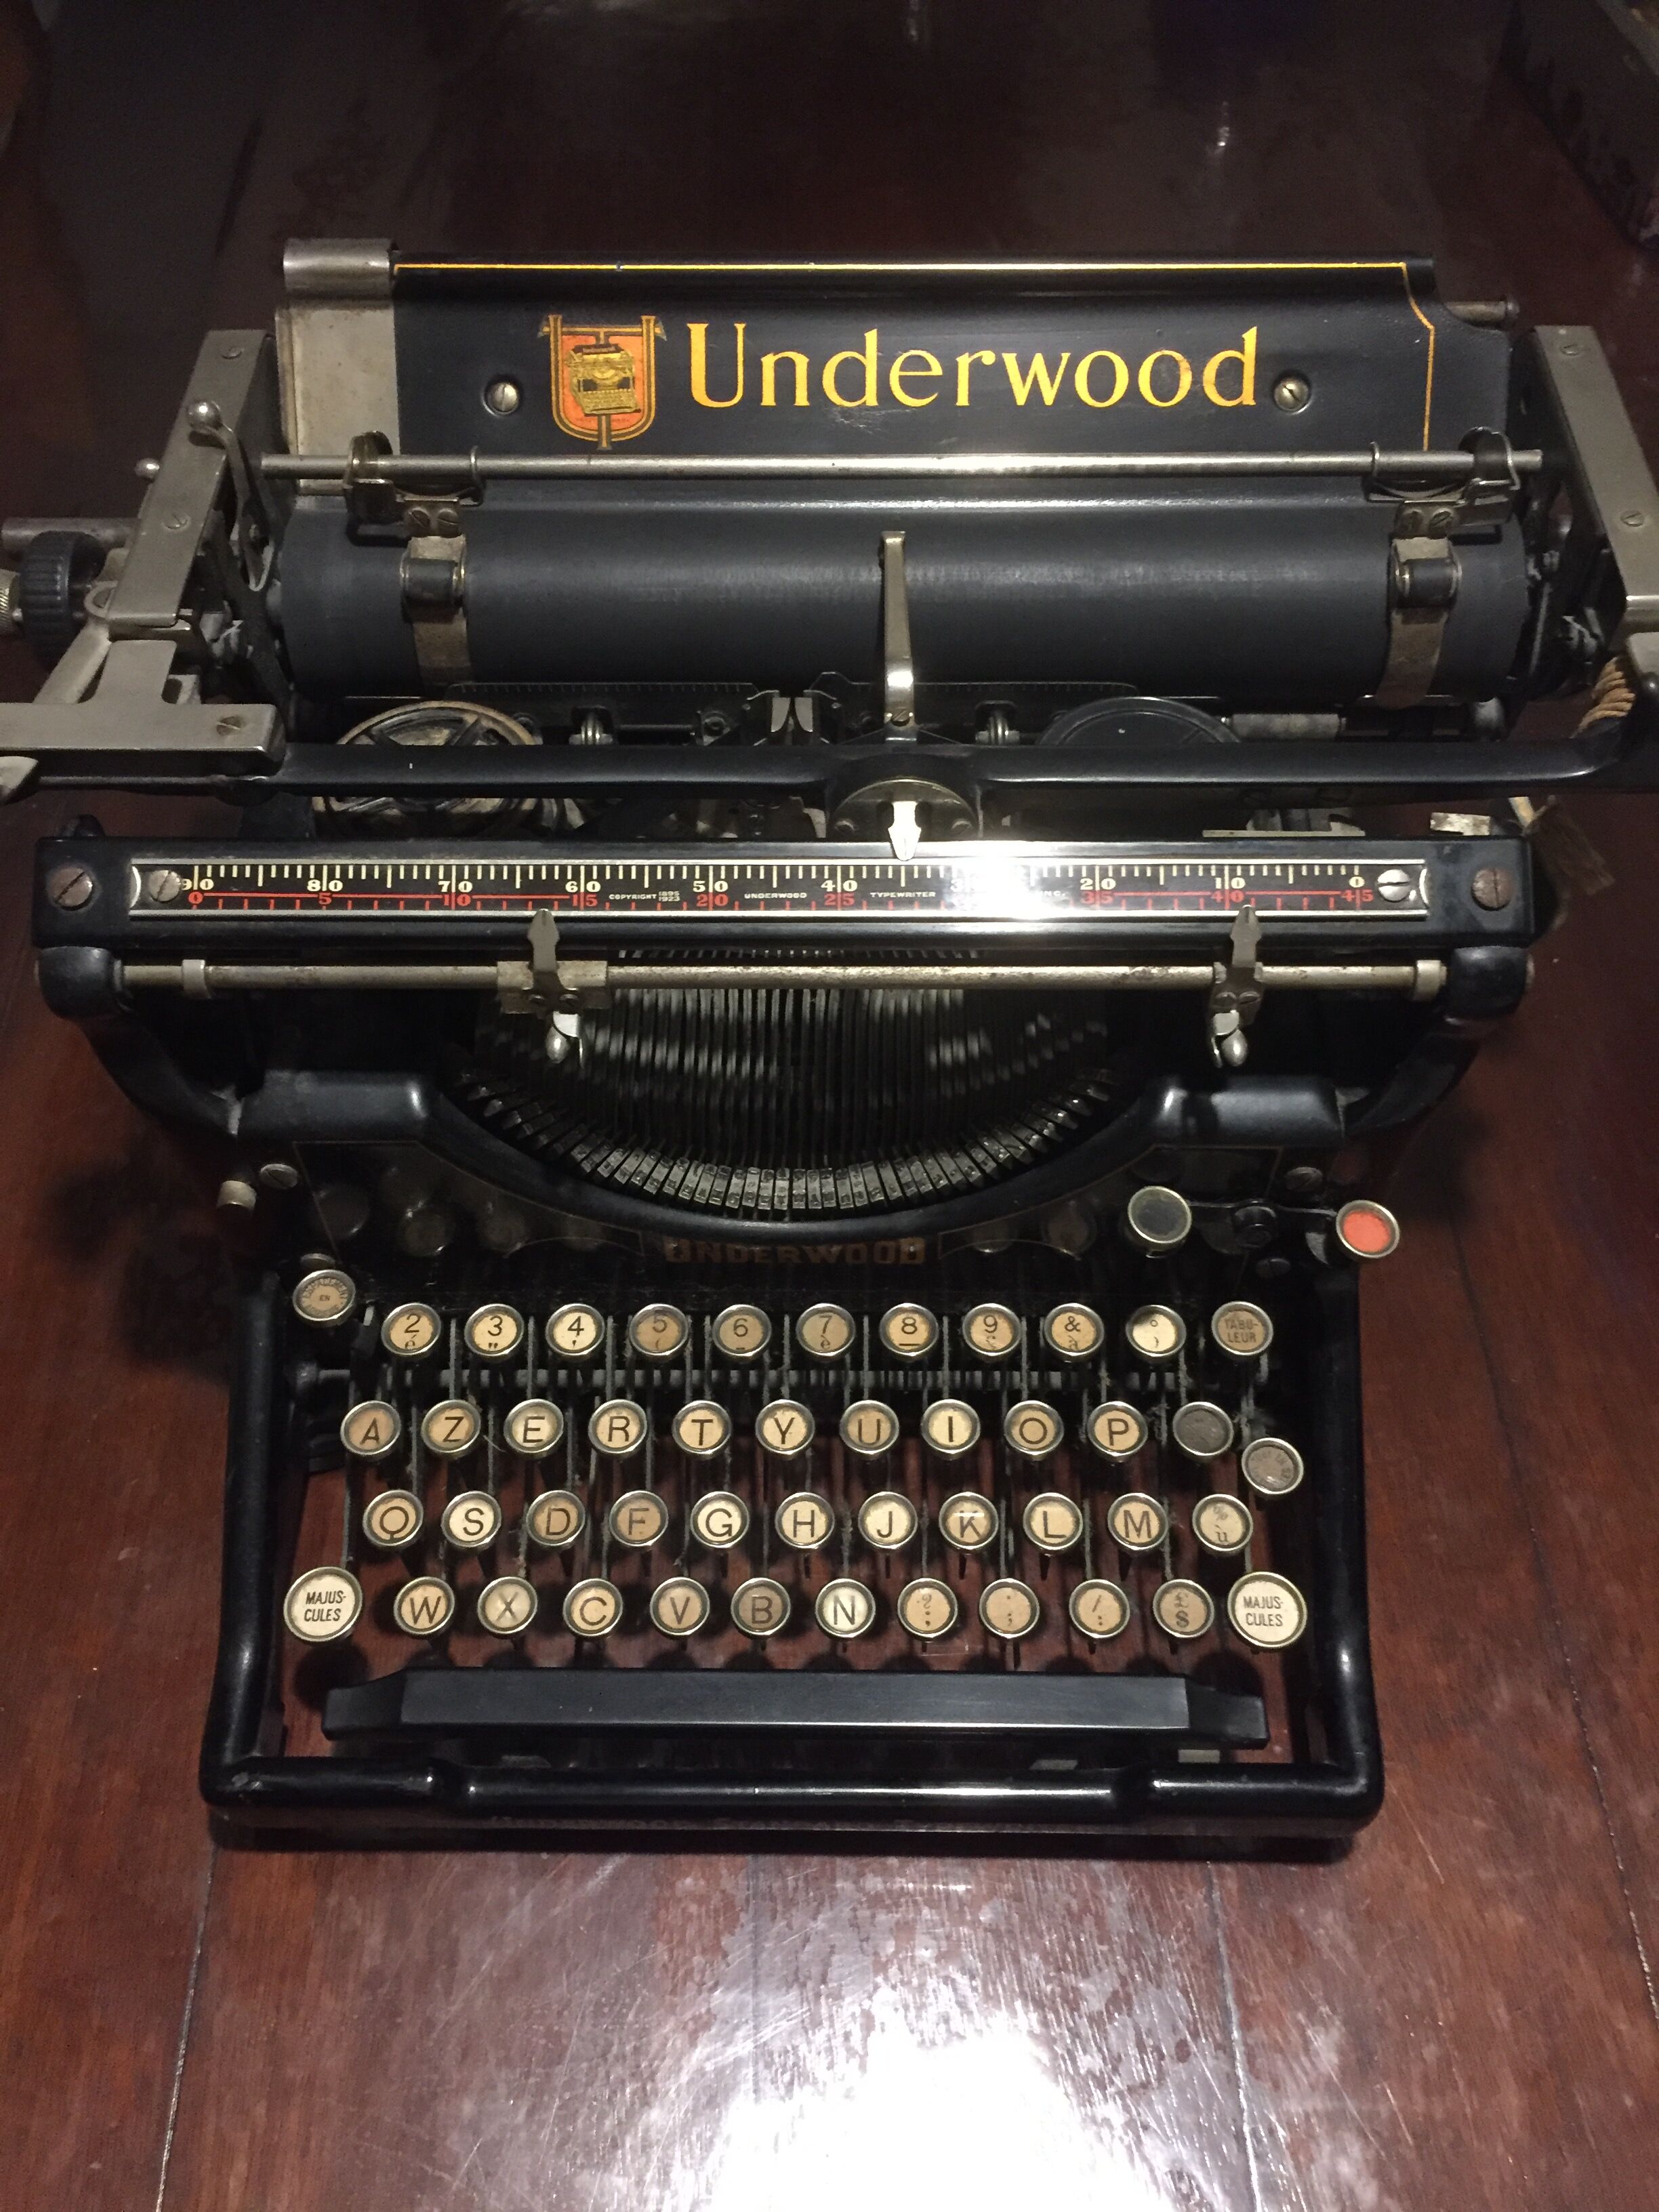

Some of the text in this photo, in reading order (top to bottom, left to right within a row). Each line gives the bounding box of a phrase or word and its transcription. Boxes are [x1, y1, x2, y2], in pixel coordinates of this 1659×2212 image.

[686, 323, 1258, 409] Underwood
[307, 880, 343, 891] 80
[438, 880, 473, 892] 70
[565, 880, 601, 893] 60
[693, 880, 729, 893] 50
[821, 880, 857, 892] 40
[1080, 878, 1116, 890] 20
[696, 894, 729, 907] 20
[824, 893, 855, 906] 25
[663, 1236, 926, 1266] UNDERWOOD
[404, 1313, 420, 1334] 2
[487, 1315, 502, 1336] 3
[567, 1315, 585, 1337] 4
[653, 1310, 668, 1334] 5
[733, 1317, 749, 1338] 6
[819, 1315, 833, 1335] 7
[901, 1316, 918, 1335] 8
[983, 1315, 998, 1334] 9
[1064, 1315, 1082, 1332] &
[1223, 1317, 1259, 1330] TABU-
[1227, 1332, 1257, 1344] LEUR
[360, 1417, 380, 1445] A
[443, 1416, 465, 1443] Z
[522, 1416, 545, 1443] E
[608, 1415, 630, 1442] R
[691, 1418, 714, 1446] T
[773, 1417, 795, 1445] Y
[857, 1418, 882, 1445] U
[947, 1416, 954, 1443] I
[1019, 1417, 1048, 1445] O
[1107, 1418, 1130, 1446] P
[379, 1506, 409, 1540] Q
[463, 1507, 485, 1536] S
[546, 1507, 571, 1536] D
[628, 1508, 650, 1536] F
[705, 1508, 733, 1537] G
[793, 1509, 815, 1538] H
[876, 1511, 893, 1538] J
[959, 1510, 983, 1539] K
[1042, 1510, 1067, 1538] L
[1124, 1509, 1152, 1539] M
[305, 1589, 347, 1605] MAJUS-
[409, 1595, 442, 1625] W
[494, 1591, 524, 1624] X
[670, 1596, 691, 1625] V
[752, 1595, 773, 1624] B
[833, 1595, 856, 1626] N
[1243, 1595, 1284, 1610] MAJUS-
[304, 1608, 342, 1622] CULES
[579, 1596, 608, 1626] C
[1245, 1613, 1284, 1628] CULES
